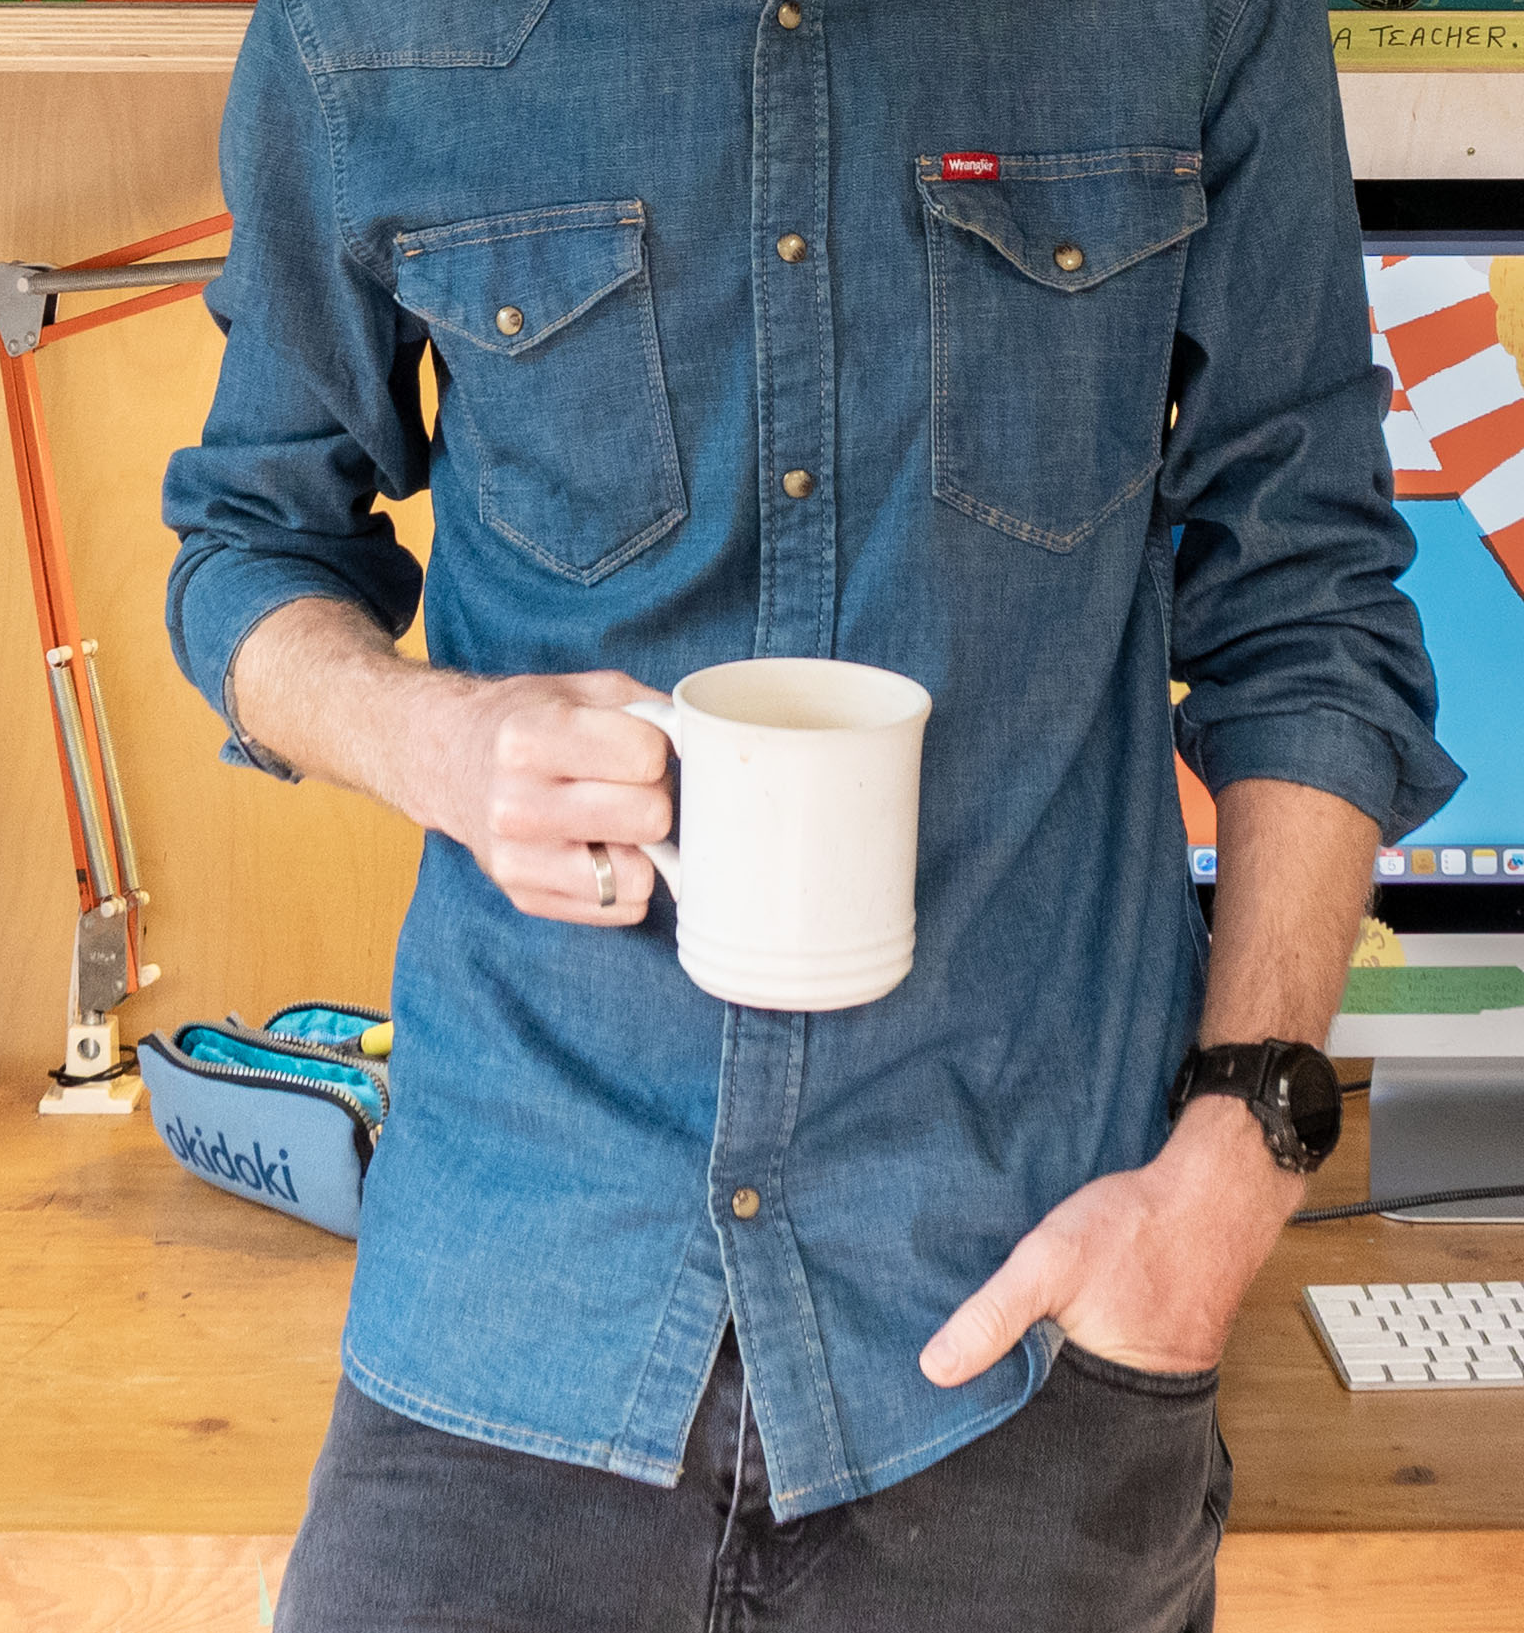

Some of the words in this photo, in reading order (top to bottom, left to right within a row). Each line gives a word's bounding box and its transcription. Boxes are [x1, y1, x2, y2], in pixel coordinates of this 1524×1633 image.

[1333, 28, 1352, 50] A
[1369, 25, 1519, 50] TEACHER.
[948, 158, 994, 175] Wrangler
[165, 1116, 299, 1204] okidoki
